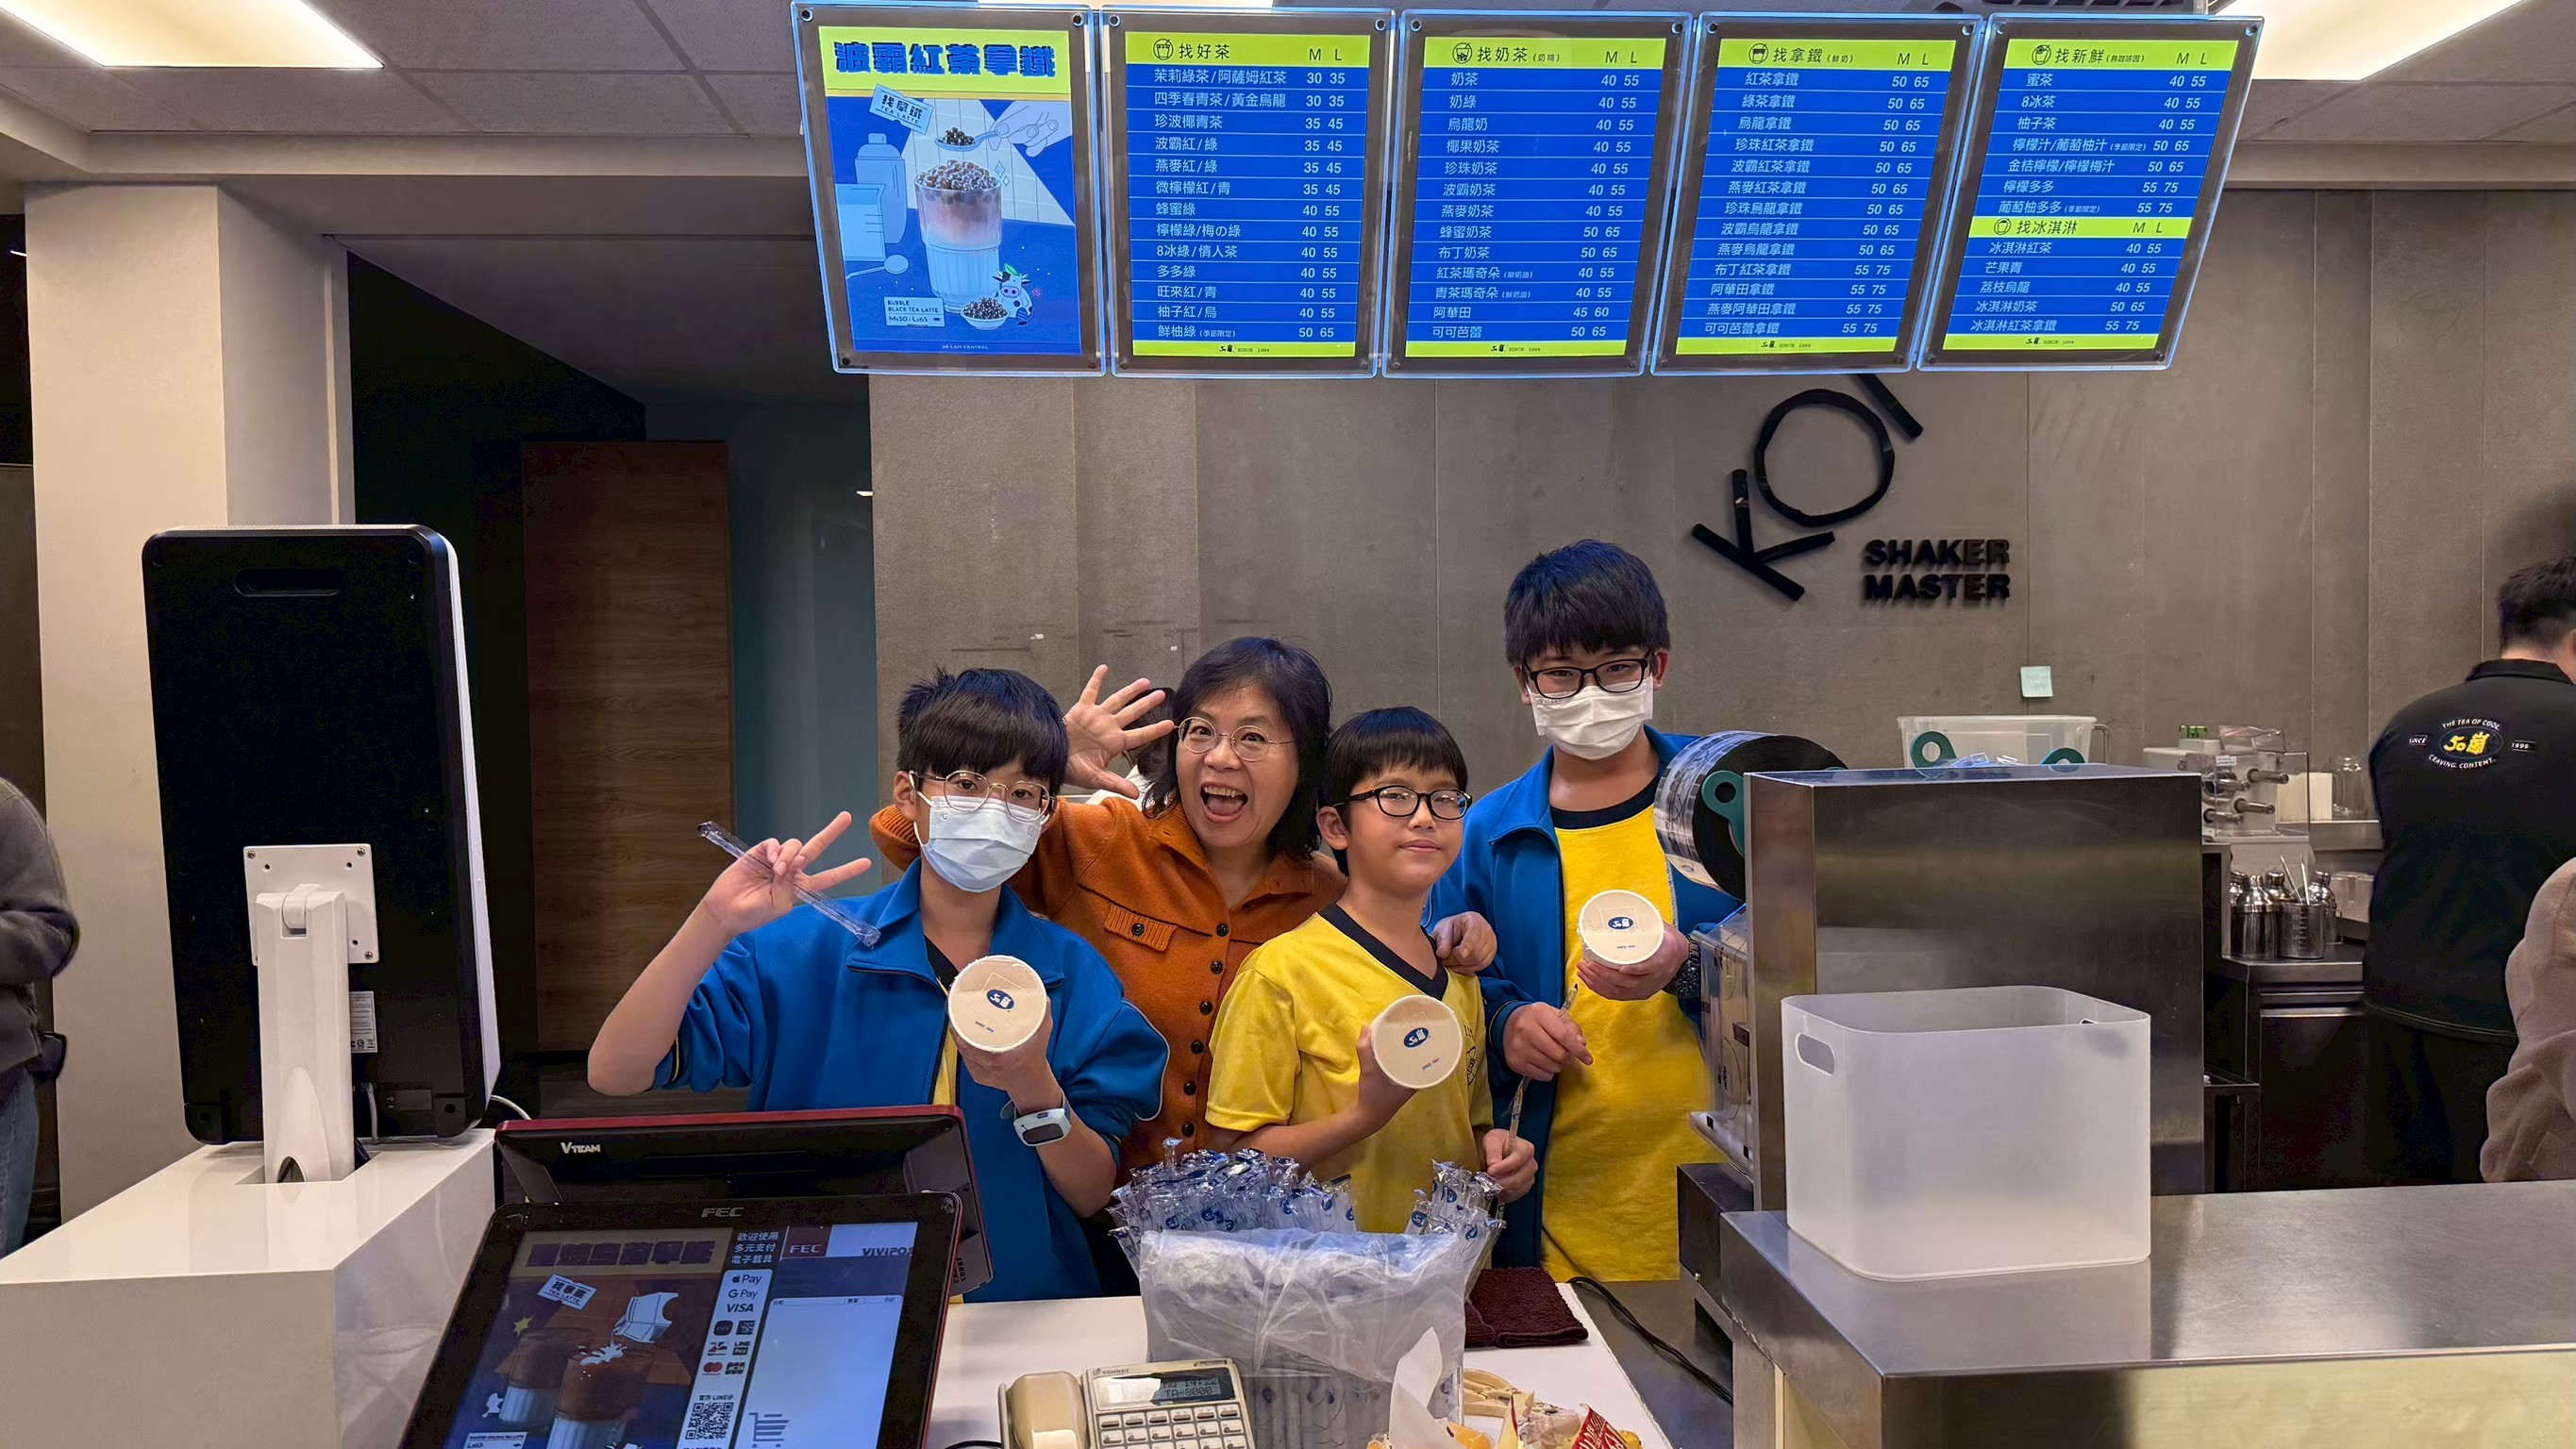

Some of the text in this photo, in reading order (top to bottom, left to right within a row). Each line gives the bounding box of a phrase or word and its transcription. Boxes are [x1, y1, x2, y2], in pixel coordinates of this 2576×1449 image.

[834, 42, 1055, 76] 波霸紅茶拿鐵
[1310, 49, 1321, 60] M
[1335, 49, 1342, 60] L
[1606, 51, 1617, 63] M
[1631, 51, 1637, 63] L
[1898, 53, 1910, 64] M
[1922, 54, 1928, 65] L
[2177, 53, 2189, 64] M
[2200, 53, 2206, 64] L
[1307, 73, 1322, 84] 30
[1330, 73, 1345, 84] 35
[1451, 72, 1639, 86] 奶茶 40 55
[1745, 72, 1930, 87] 紅茶拿鐵 50 65
[2026, 74, 2206, 87] 蜜茶 40 55
[1306, 95, 1321, 107] 30
[1330, 95, 1344, 107] 35
[1449, 95, 1636, 108] 奶綠 40 55
[1742, 94, 1925, 109] 綠茶拿鐵 50 65
[2022, 95, 2055, 108] 8冰茶
[1155, 114, 1343, 129] 珍波椰青茶 35 45
[1448, 117, 1487, 131] 烏龍奶
[1738, 116, 1792, 130] 烏龍拿鐵
[2017, 117, 2056, 129] 柚子茶
[1305, 141, 1319, 151] 35
[1328, 141, 1342, 151] 45
[1447, 140, 1499, 153] 椰果奶茶
[2153, 141, 2168, 151] 50
[2175, 141, 2189, 151] 65
[1304, 162, 1318, 173] 35
[1327, 162, 1341, 174] 45
[1445, 161, 1497, 175] 珍珠奶茶
[1304, 184, 1318, 194] 35
[1326, 184, 1340, 195] 45
[1443, 183, 1496, 196] 波霸奶茶
[2003, 180, 2053, 192] 檸檬多多
[1156, 202, 1196, 215] 蜂蜜綠
[1442, 205, 1494, 217] 燕麥奶茶
[1999, 201, 2062, 213] 葡萄柚多多
[1440, 225, 1620, 239] 蜂蜜奶茶 50 65
[2133, 223, 2146, 233] M
[2156, 223, 2162, 233] L
[1439, 246, 1490, 258] 布丁奶茶
[1989, 242, 2052, 254] 冰淇淋紅茶
[1158, 265, 1196, 277] 多多綠
[1436, 267, 1500, 278] 紅茶瑪奇朵
[1855, 265, 1869, 275] 55
[1877, 265, 1891, 275] 75
[1985, 261, 2022, 274] 芒果青
[1436, 287, 1497, 299] 青茶瑪奇朵
[1711, 283, 1774, 295] 阿華田拿鐵
[1434, 307, 1609, 318] 阿華田 45 60
[1975, 301, 2145, 312] 冰淇淋奶茶 50 65
[1159, 325, 1196, 337] 鮮柚綠
[1432, 326, 1481, 338] 可可芭蕾
[1842, 324, 1857, 333] 55
[1864, 324, 1878, 333] 75
[1865, 540, 2010, 566] SHAKER
[1865, 574, 2010, 599] MASTER
[701, 1208, 744, 1217] FEC
[734, 1243, 776, 1253] 多元支付
[790, 1244, 822, 1253] FEC
[742, 1275, 762, 1284] Pay
[740, 1290, 758, 1299] Pay
[727, 1304, 754, 1312] VISA
[1165, 1387, 1213, 1396] TA-8000
